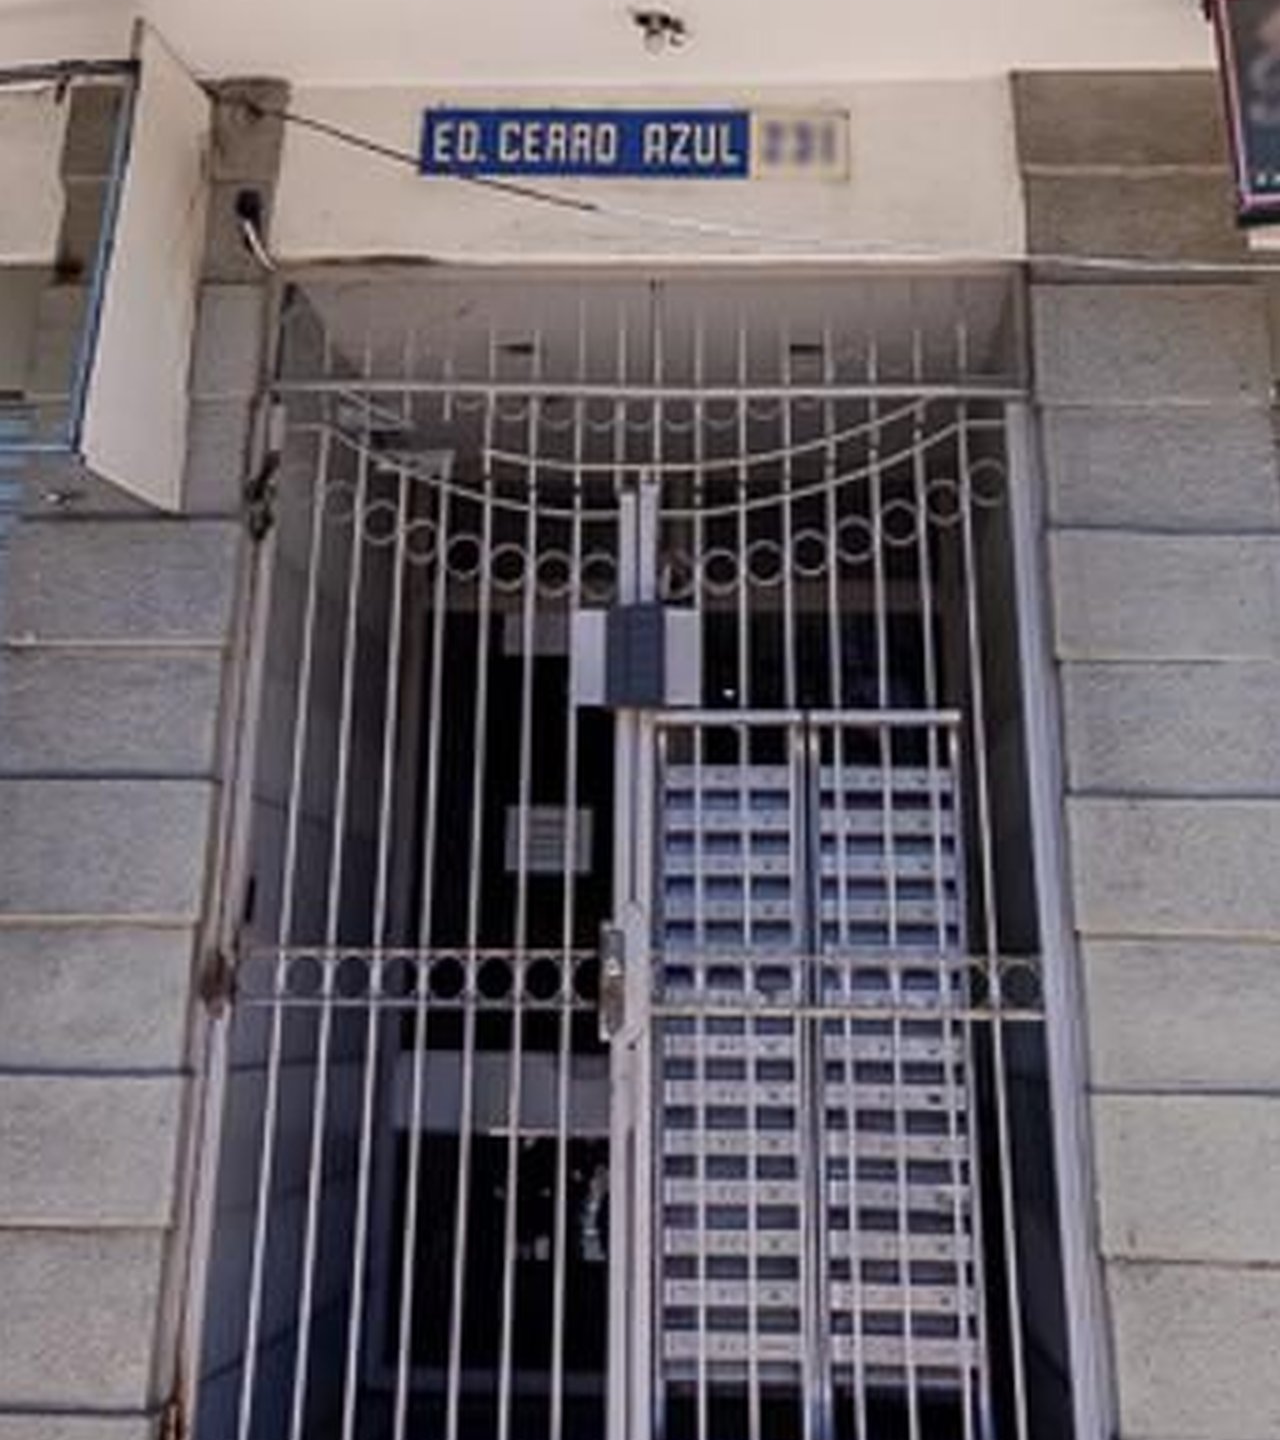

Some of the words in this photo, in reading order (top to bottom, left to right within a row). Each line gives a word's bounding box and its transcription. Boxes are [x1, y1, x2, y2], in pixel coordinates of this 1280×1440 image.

[433, 121, 486, 164] ED.
[498, 121, 617, 165] CERRO
[643, 121, 740, 166] AZUL
